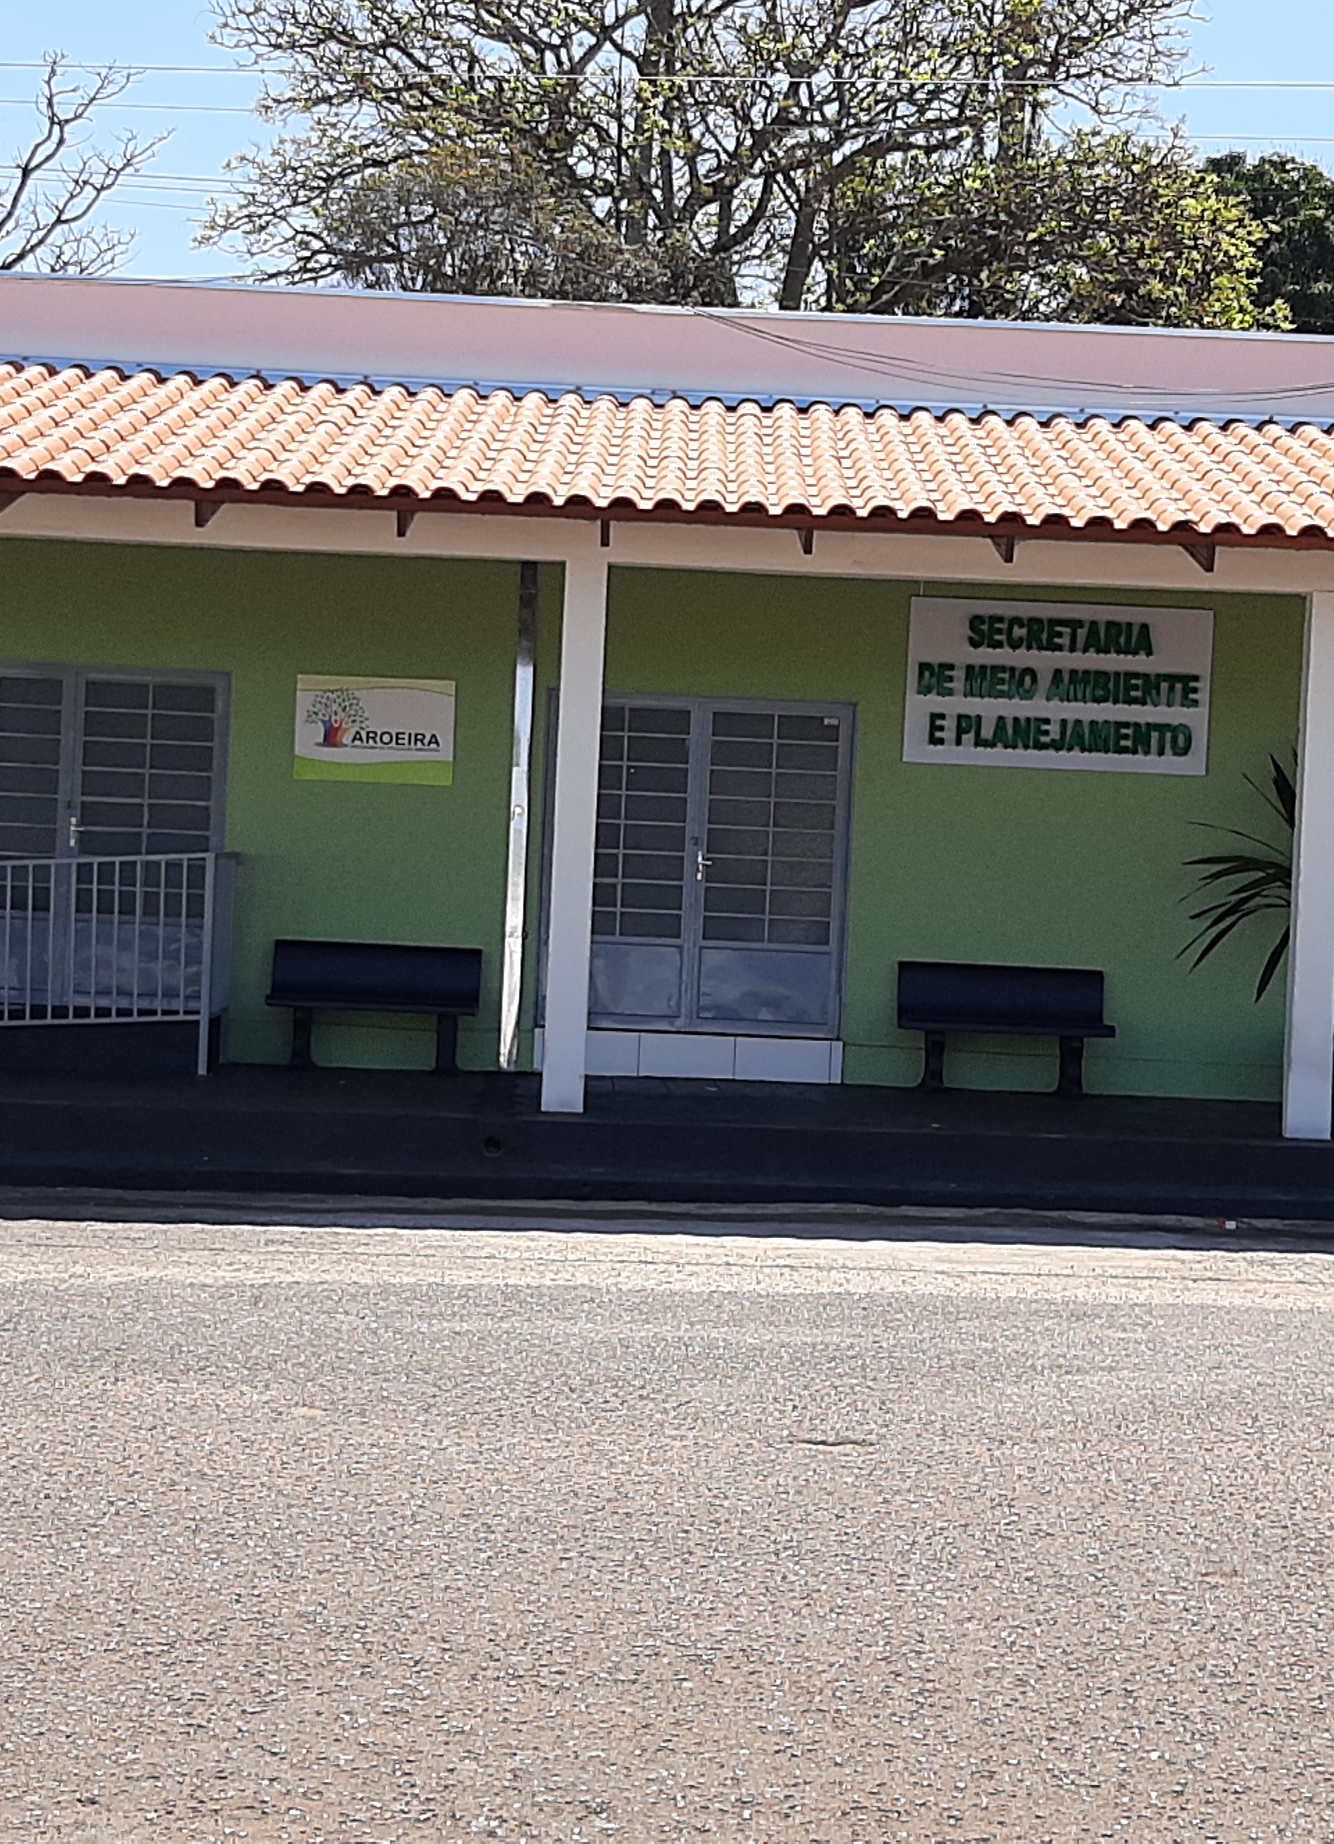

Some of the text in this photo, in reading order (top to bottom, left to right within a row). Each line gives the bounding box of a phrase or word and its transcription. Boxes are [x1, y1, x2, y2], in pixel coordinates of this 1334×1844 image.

[968, 614, 1154, 657] SECRETARIA
[917, 662, 1200, 708] DE MEIO AMBIENTE
[351, 730, 441, 747] AROEIRA
[928, 711, 1193, 757] E PLANEJAMENTO
